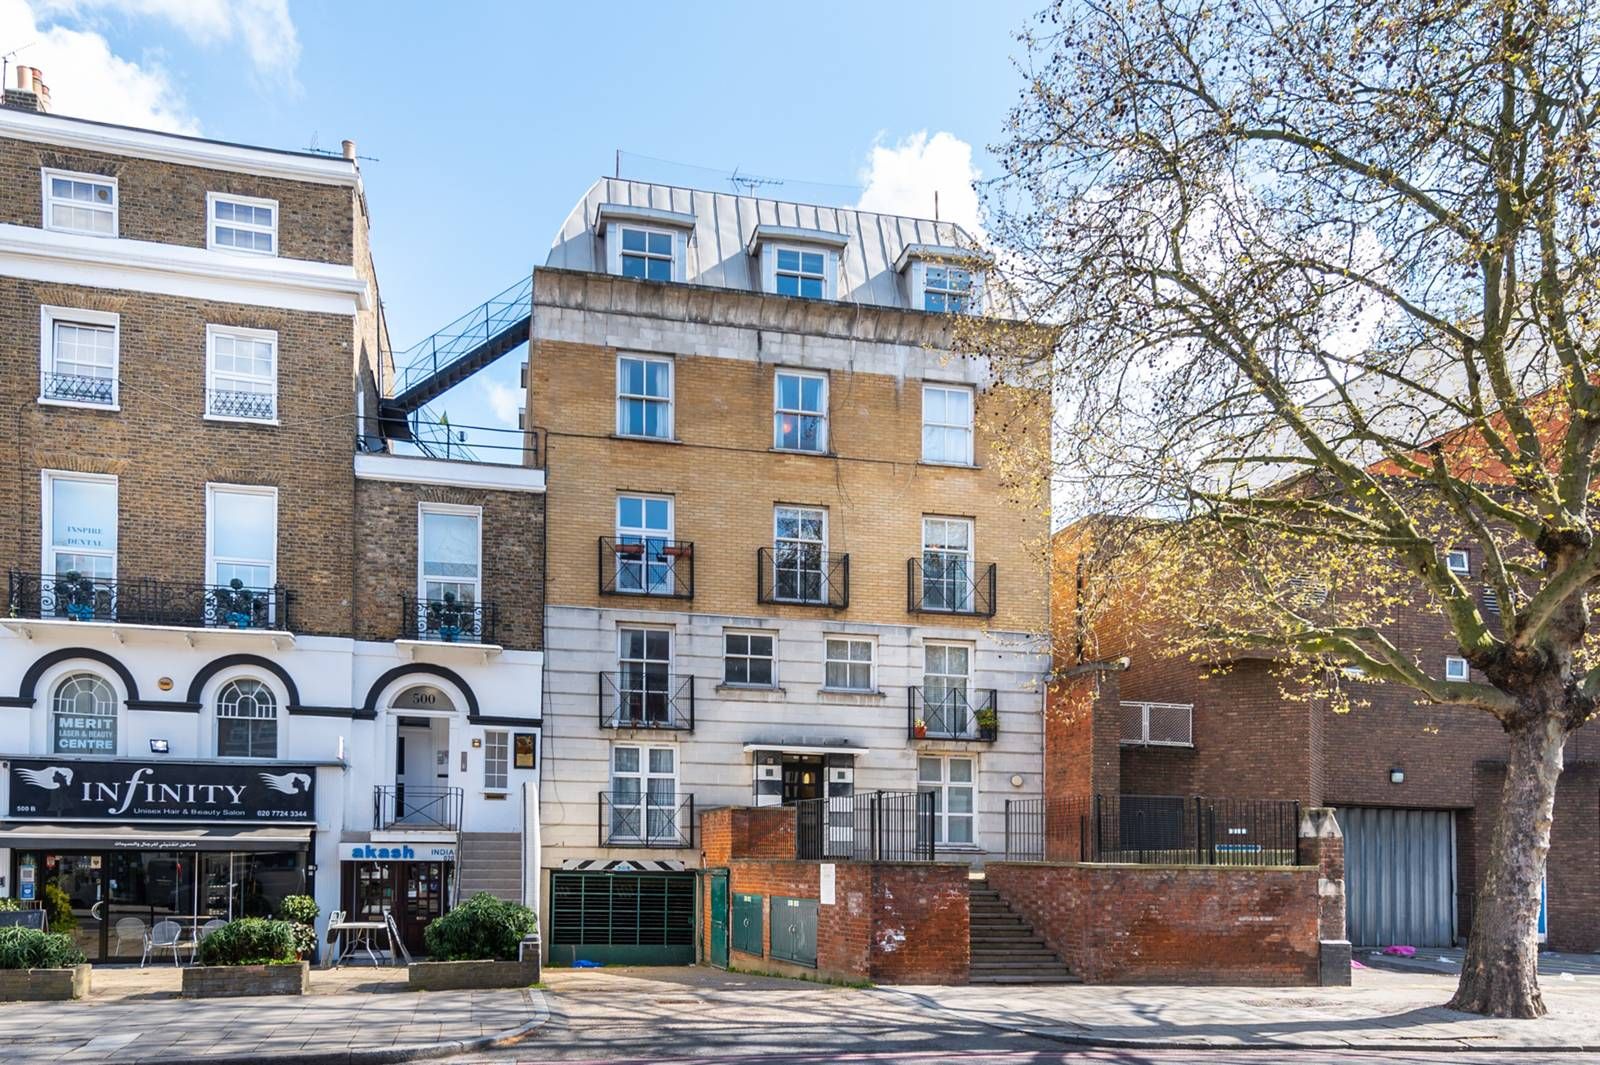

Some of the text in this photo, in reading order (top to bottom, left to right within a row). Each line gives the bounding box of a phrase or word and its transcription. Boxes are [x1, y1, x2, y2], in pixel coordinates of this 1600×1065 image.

[67, 526, 103, 535] INSPIRE
[67, 538, 104, 547] DENTAL
[412, 693, 436, 705] 500
[59, 717, 113, 729] MERIT
[58, 729, 80, 737] LASER
[88, 730, 113, 738] BEAUTY
[59, 738, 113, 749] CENTRE
[351, 845, 415, 859] akash
